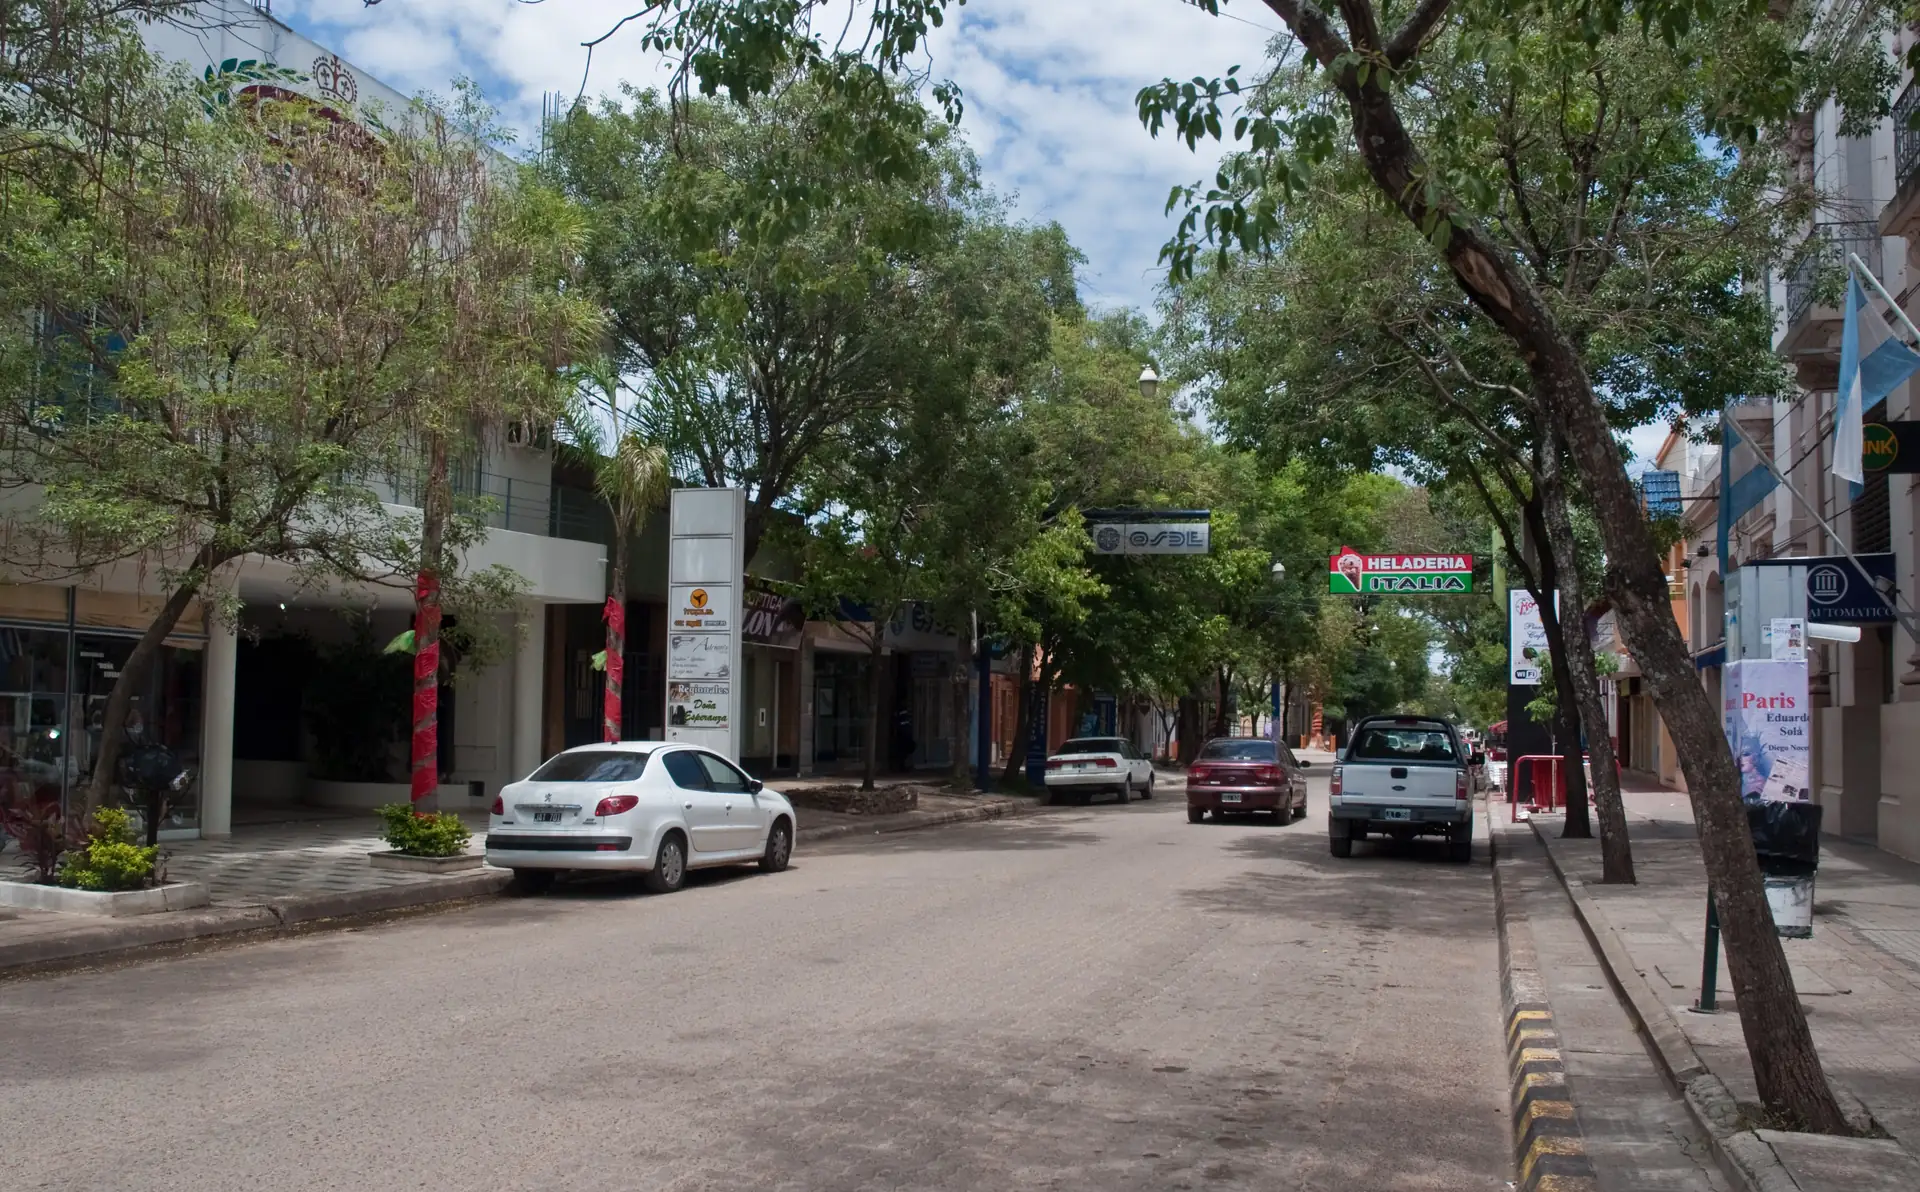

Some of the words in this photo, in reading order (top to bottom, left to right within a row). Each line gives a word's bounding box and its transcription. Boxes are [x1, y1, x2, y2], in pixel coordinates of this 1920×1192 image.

[1129, 531, 1204, 547] OSDE
[1367, 557, 1467, 570] HELADERIA
[1369, 575, 1466, 591] ITALIA
[678, 684, 730, 697] Regionales
[693, 699, 717, 710] Doña
[1742, 691, 1796, 709] Paris
[684, 710, 728, 725] Esperanza
